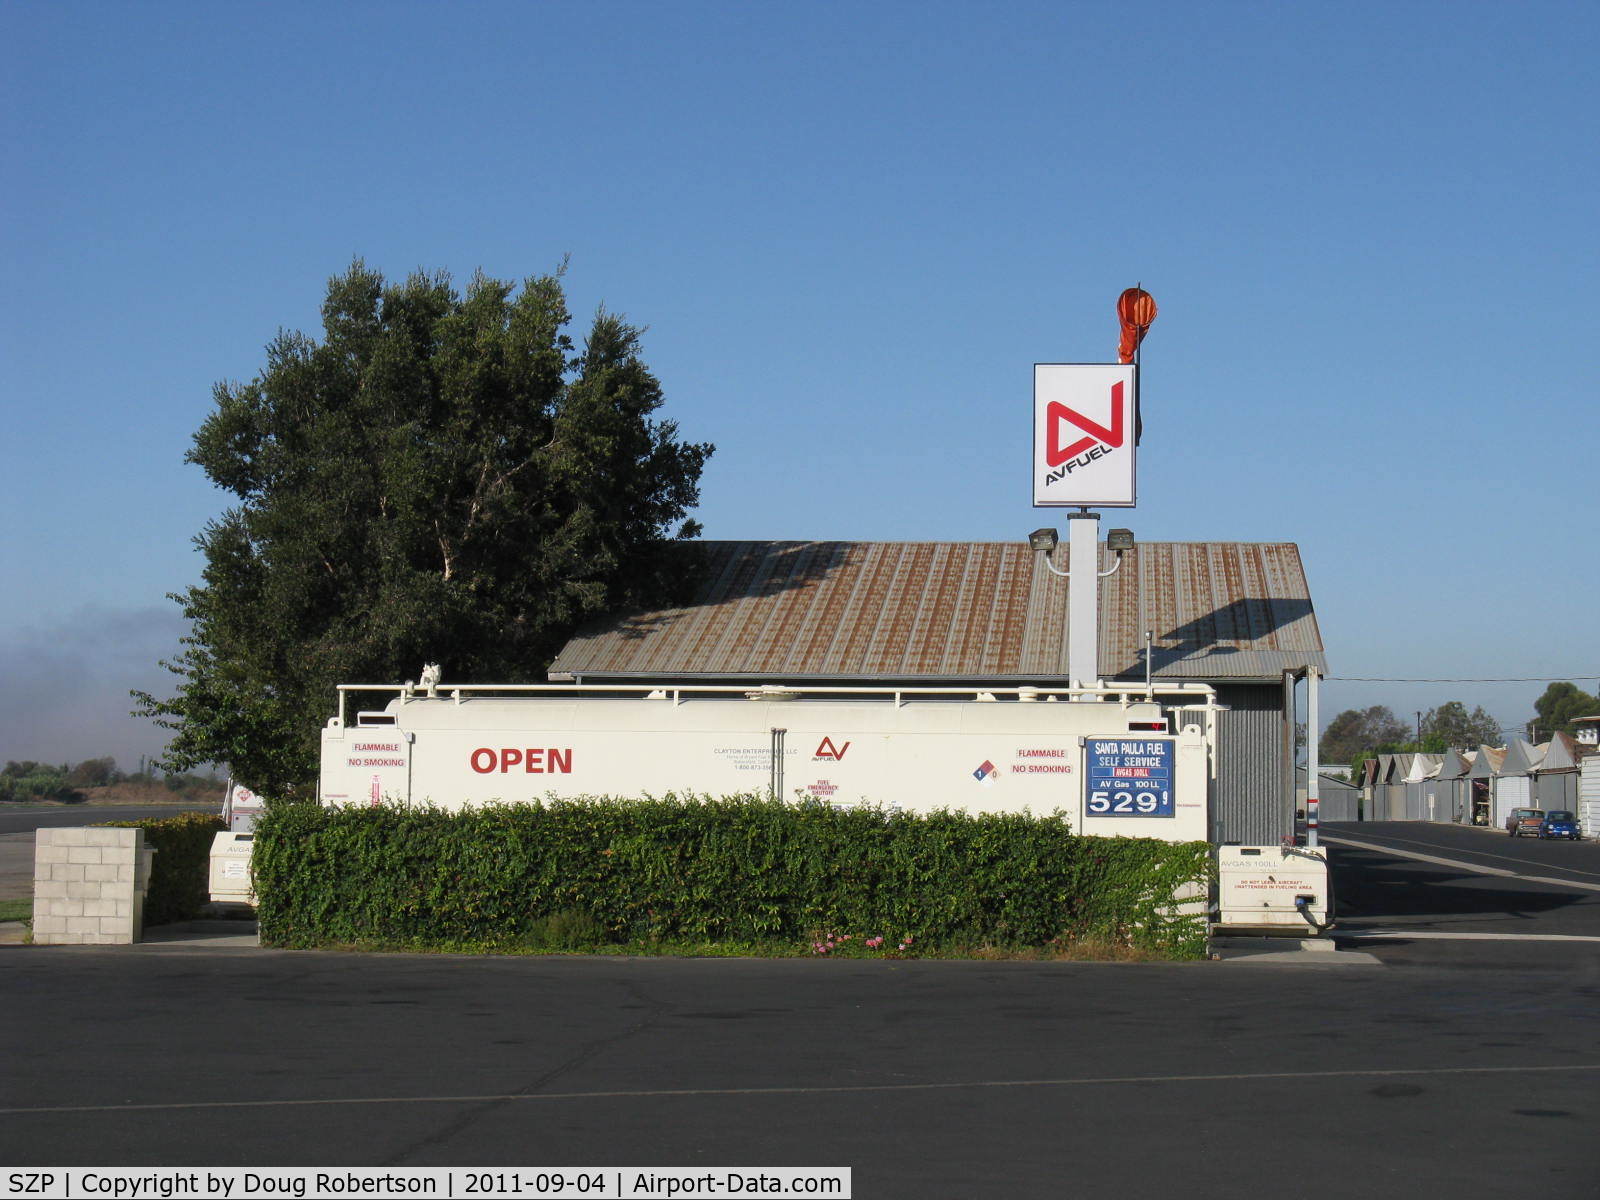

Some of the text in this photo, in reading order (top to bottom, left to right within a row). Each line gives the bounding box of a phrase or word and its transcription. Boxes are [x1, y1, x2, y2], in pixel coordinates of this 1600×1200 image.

[1045, 444, 1112, 487] AVFUEL
[354, 743, 399, 751] FLAMMABLE
[1095, 742, 1165, 755] SANTA PAULA FUEL
[1018, 749, 1065, 757] FLAMMABLE
[348, 758, 404, 766] NO SMOKING
[470, 747, 572, 774] OPEN
[1099, 756, 1161, 767] SELF SERVICE
[1012, 765, 1071, 773] NO SMOKING
[1115, 768, 1132, 777] AVGAS
[1100, 780, 1160, 788] AV Gas 100 LL
[1089, 791, 1157, 813] 529
[1221, 860, 1278, 868] AVGAS 100LL
